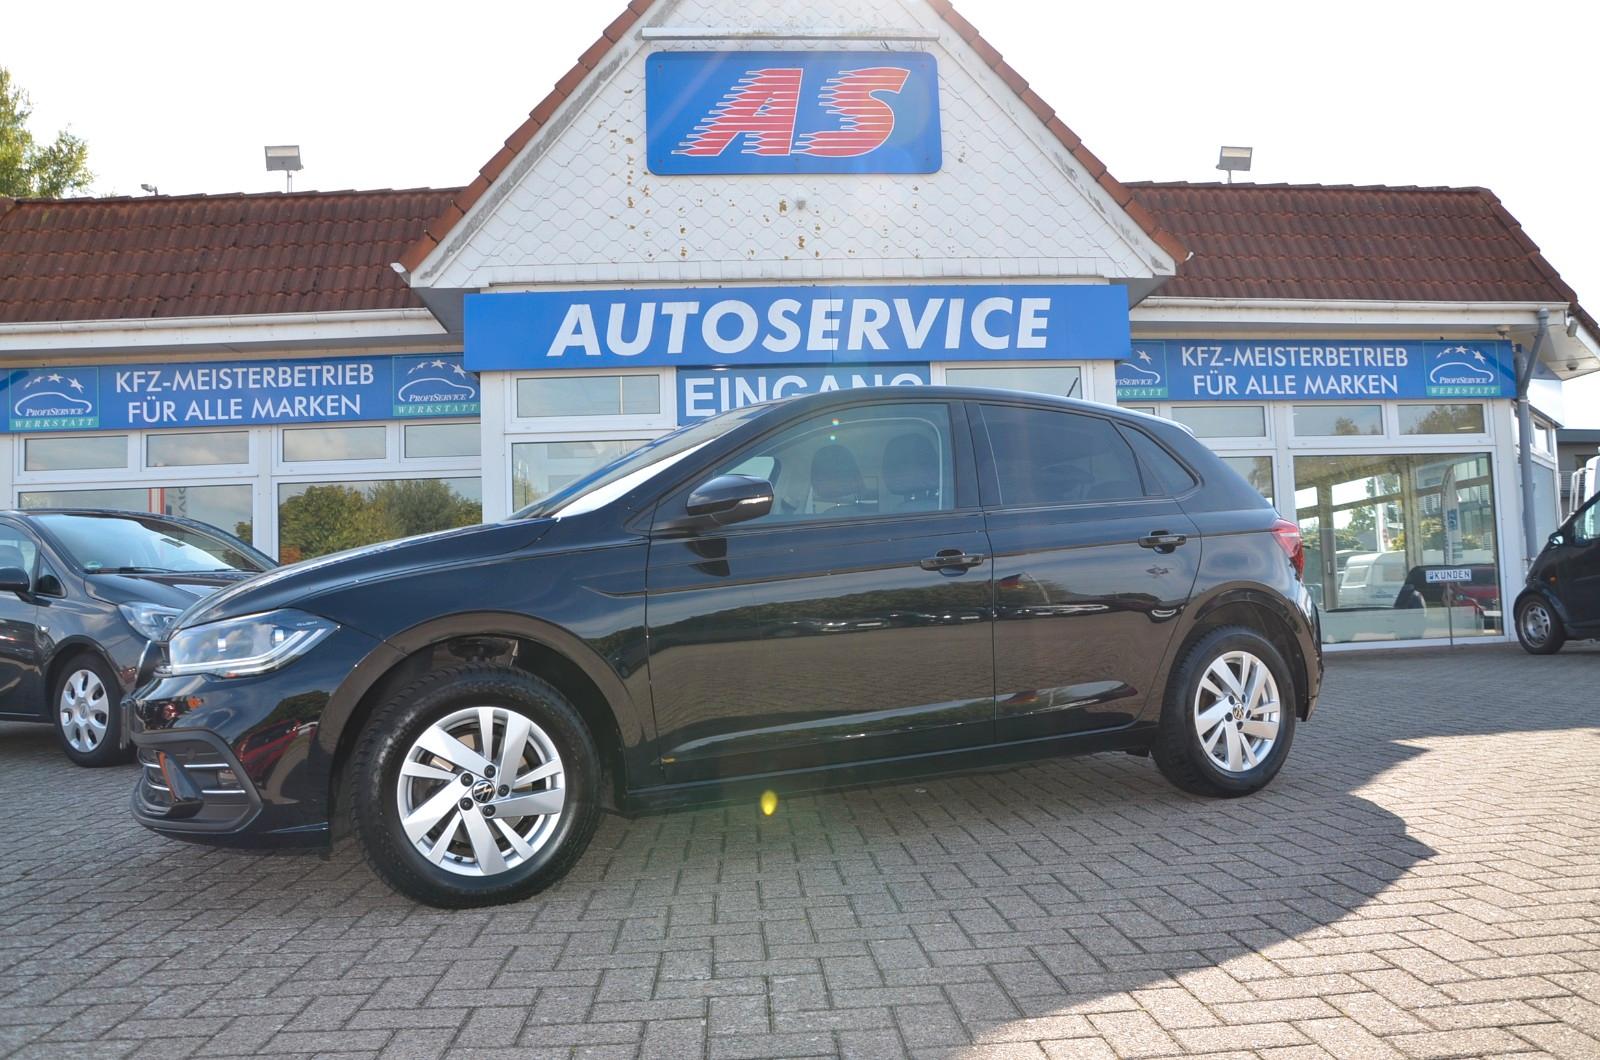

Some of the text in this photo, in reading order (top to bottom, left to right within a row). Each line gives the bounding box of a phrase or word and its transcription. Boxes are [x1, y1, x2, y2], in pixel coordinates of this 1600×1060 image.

[671, 67, 911, 158] AS
[546, 297, 1051, 357] AUTOSERVICE
[1181, 346, 1409, 368] KFZ-MEISTERBETRIEB
[116, 364, 374, 393] KFZ-MEISTERBETRIEB
[1193, 371, 1399, 395] FÜR ALLE MARKEN
[1431, 387, 1497, 395] WERKSTATT
[128, 394, 361, 424] FÜR ALLE MARKEN
[398, 403, 477, 414] WERKSTATT
[15, 418, 94, 428] WERKSTATT
